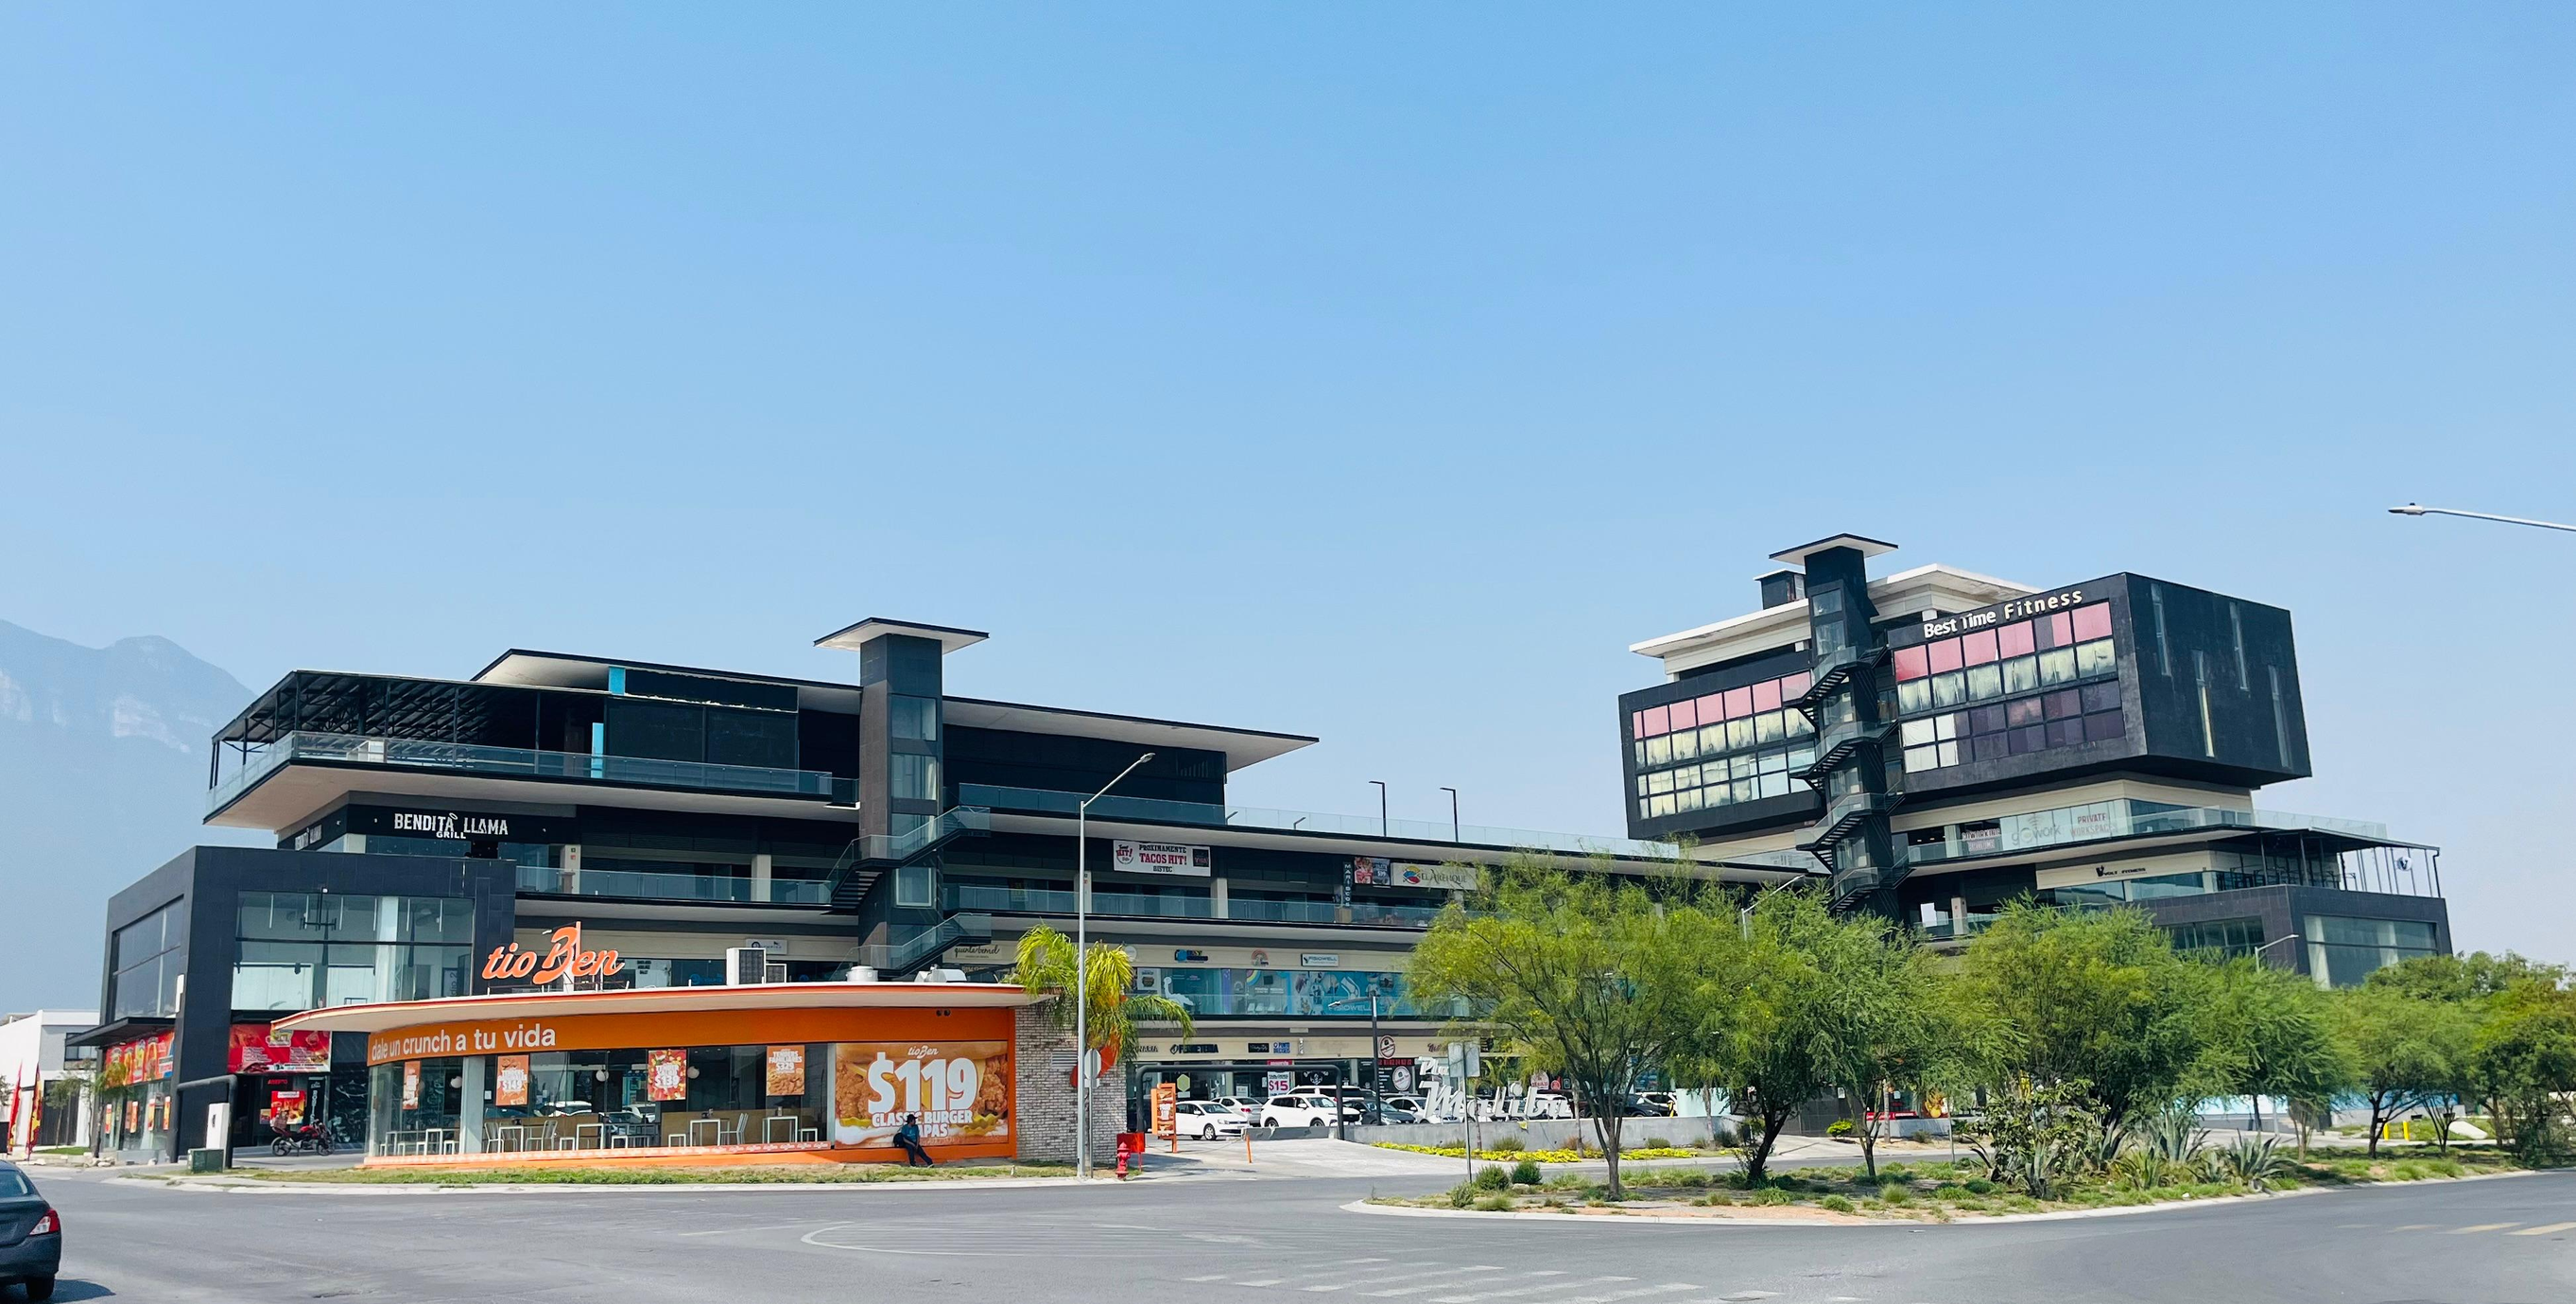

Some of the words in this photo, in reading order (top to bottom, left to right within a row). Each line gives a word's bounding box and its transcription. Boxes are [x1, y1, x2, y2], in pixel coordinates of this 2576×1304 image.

[1923, 619, 1958, 639] Best
[1961, 610, 1997, 630] Time
[2003, 590, 2083, 620] Fitness
[393, 812, 455, 832] BENDITA
[463, 817, 509, 835] LLAMA
[2077, 812, 2107, 825] PRIVATE
[436, 830, 467, 840] GRILL
[1138, 844, 1187, 854] PROXIMAMENTE
[1139, 853, 1167, 864] TACOS
[1168, 855, 1187, 865] HIT!
[482, 942, 537, 980] tio
[533, 927, 625, 984] Ben
[372, 1037, 389, 1062] dale
[389, 1040, 401, 1056] un
[403, 1029, 451, 1055] crunch
[456, 1034, 467, 1052] a
[474, 1029, 496, 1050] tu
[504, 1023, 556, 1048] vida
[1418, 1056, 1449, 1076] Pla
[868, 1052, 977, 1113] $119
[1269, 1080, 1288, 1091] $15
[873, 1110, 923, 1127] CLASSC
[924, 1109, 974, 1124] BURGER
[918, 1122, 948, 1138] APAS
